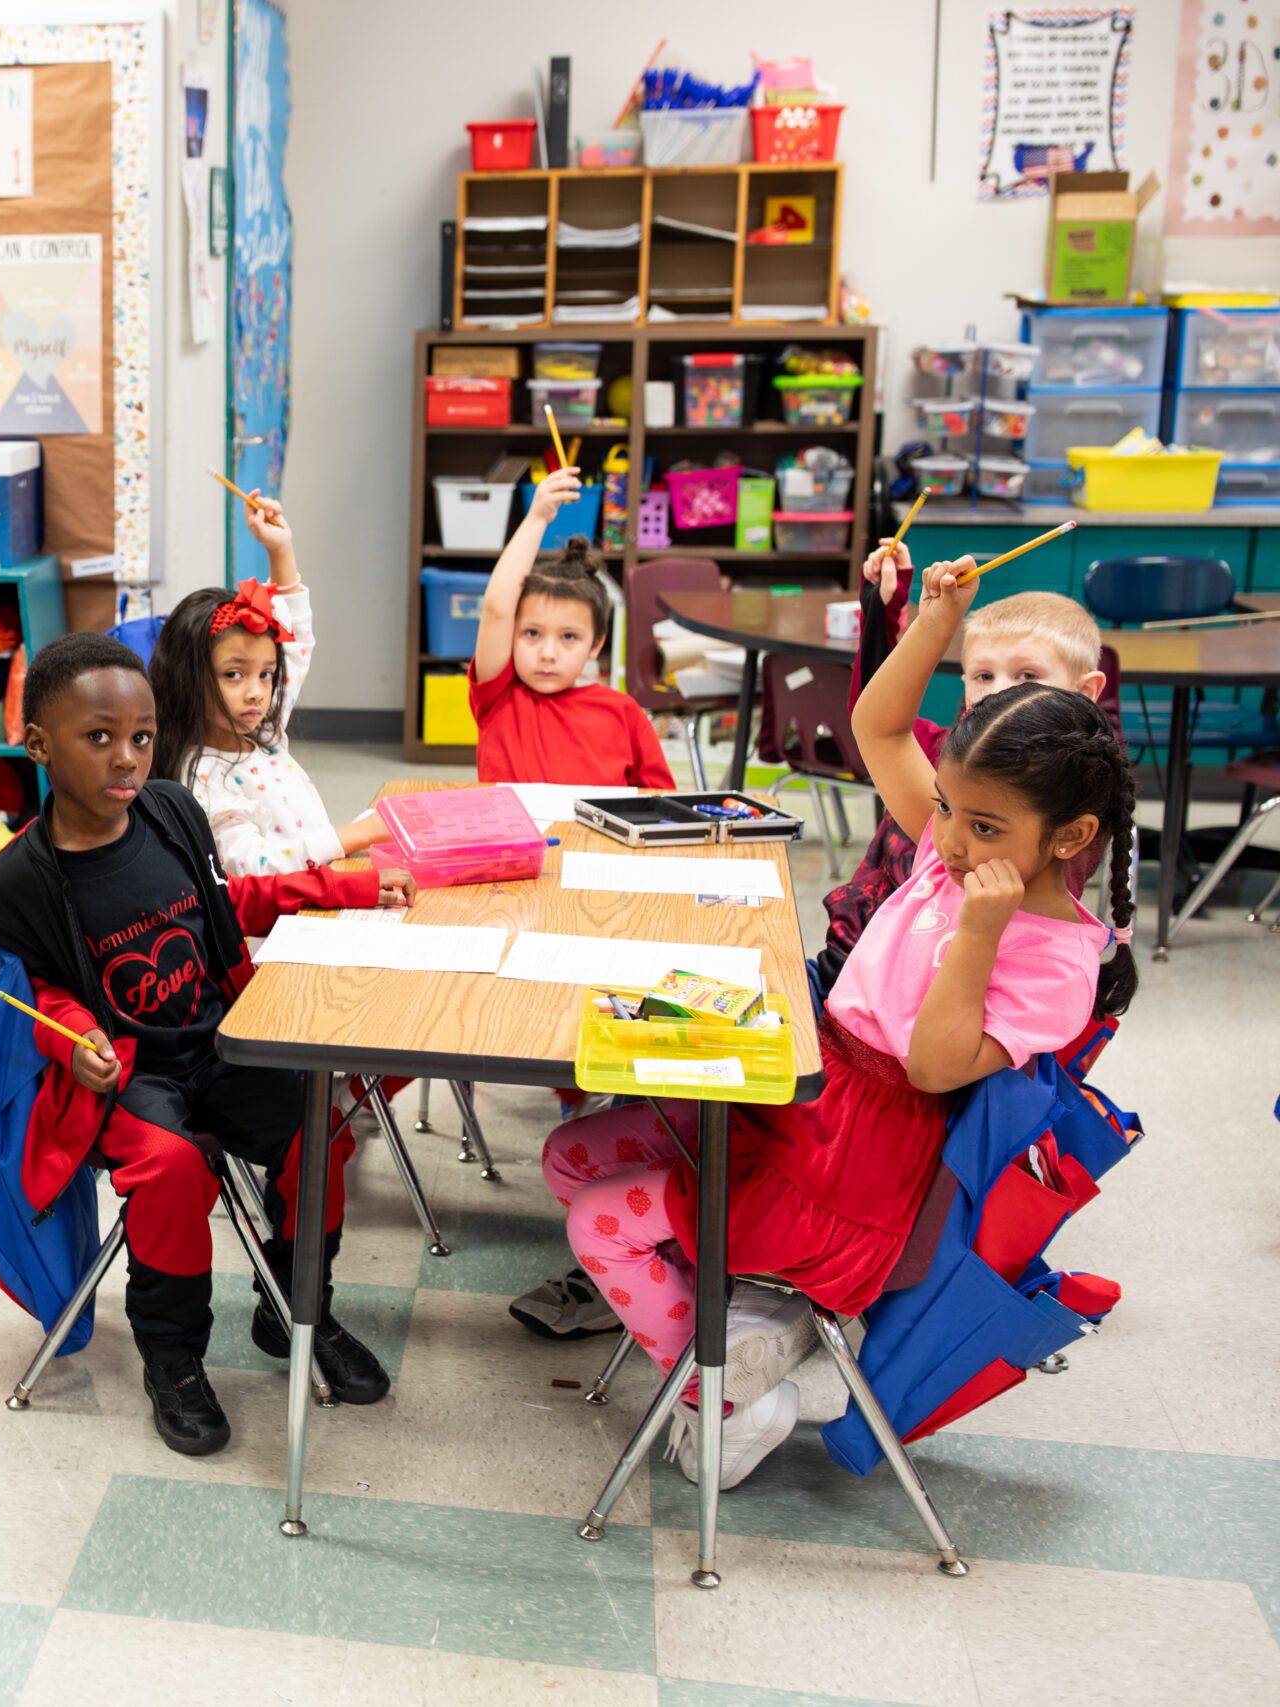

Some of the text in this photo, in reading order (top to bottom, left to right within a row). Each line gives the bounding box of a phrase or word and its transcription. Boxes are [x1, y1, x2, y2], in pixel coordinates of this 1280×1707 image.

[13, 147, 23, 185] 1
[30, 238, 93, 260] CONTROL
[13, 338, 68, 362] Myself
[125, 959, 197, 1017] Love
